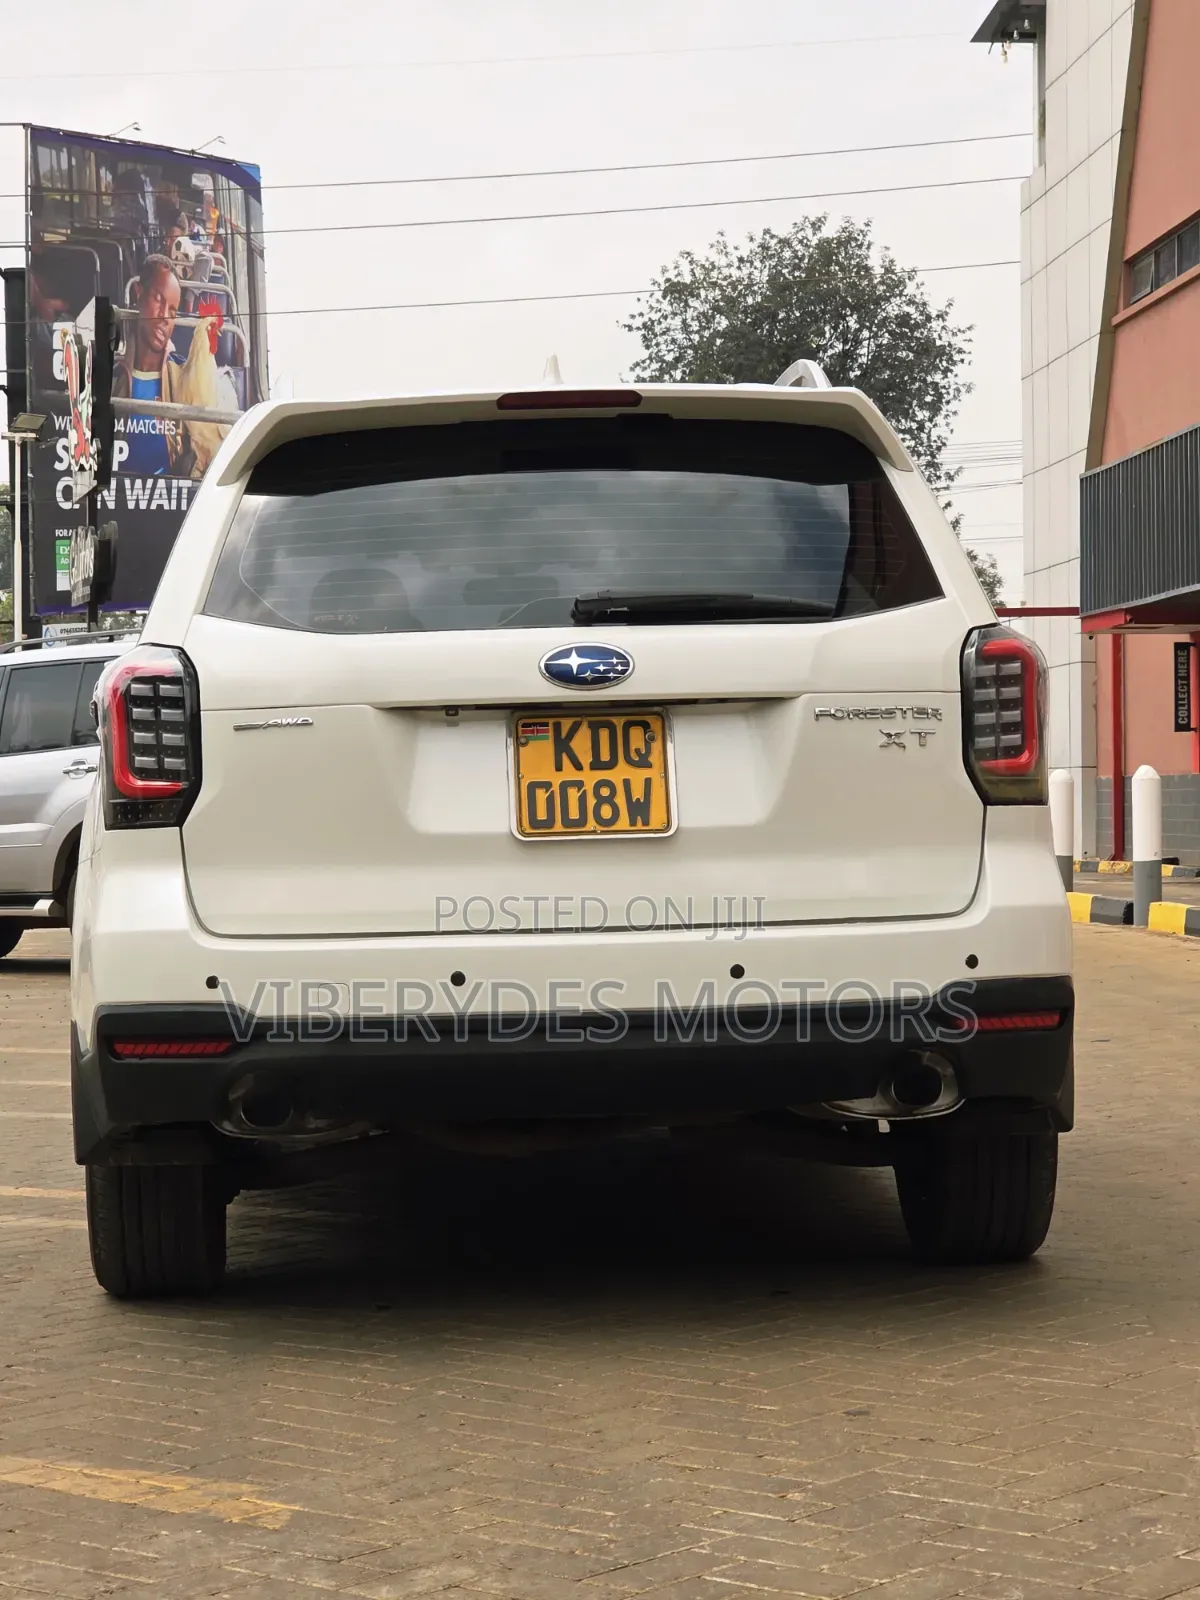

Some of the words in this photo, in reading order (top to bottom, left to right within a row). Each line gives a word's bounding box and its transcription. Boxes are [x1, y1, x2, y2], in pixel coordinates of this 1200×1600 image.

[126, 418, 176, 435] MATCHES
[55, 476, 117, 510] CN
[124, 478, 193, 511] WAIT
[1178, 649, 1188, 677] HERE
[814, 706, 943, 722] FORESTER
[1178, 679, 1188, 724] COLLECT
[552, 719, 653, 772] KDQ
[878, 728, 937, 753] XT
[526, 776, 653, 830] 008W
